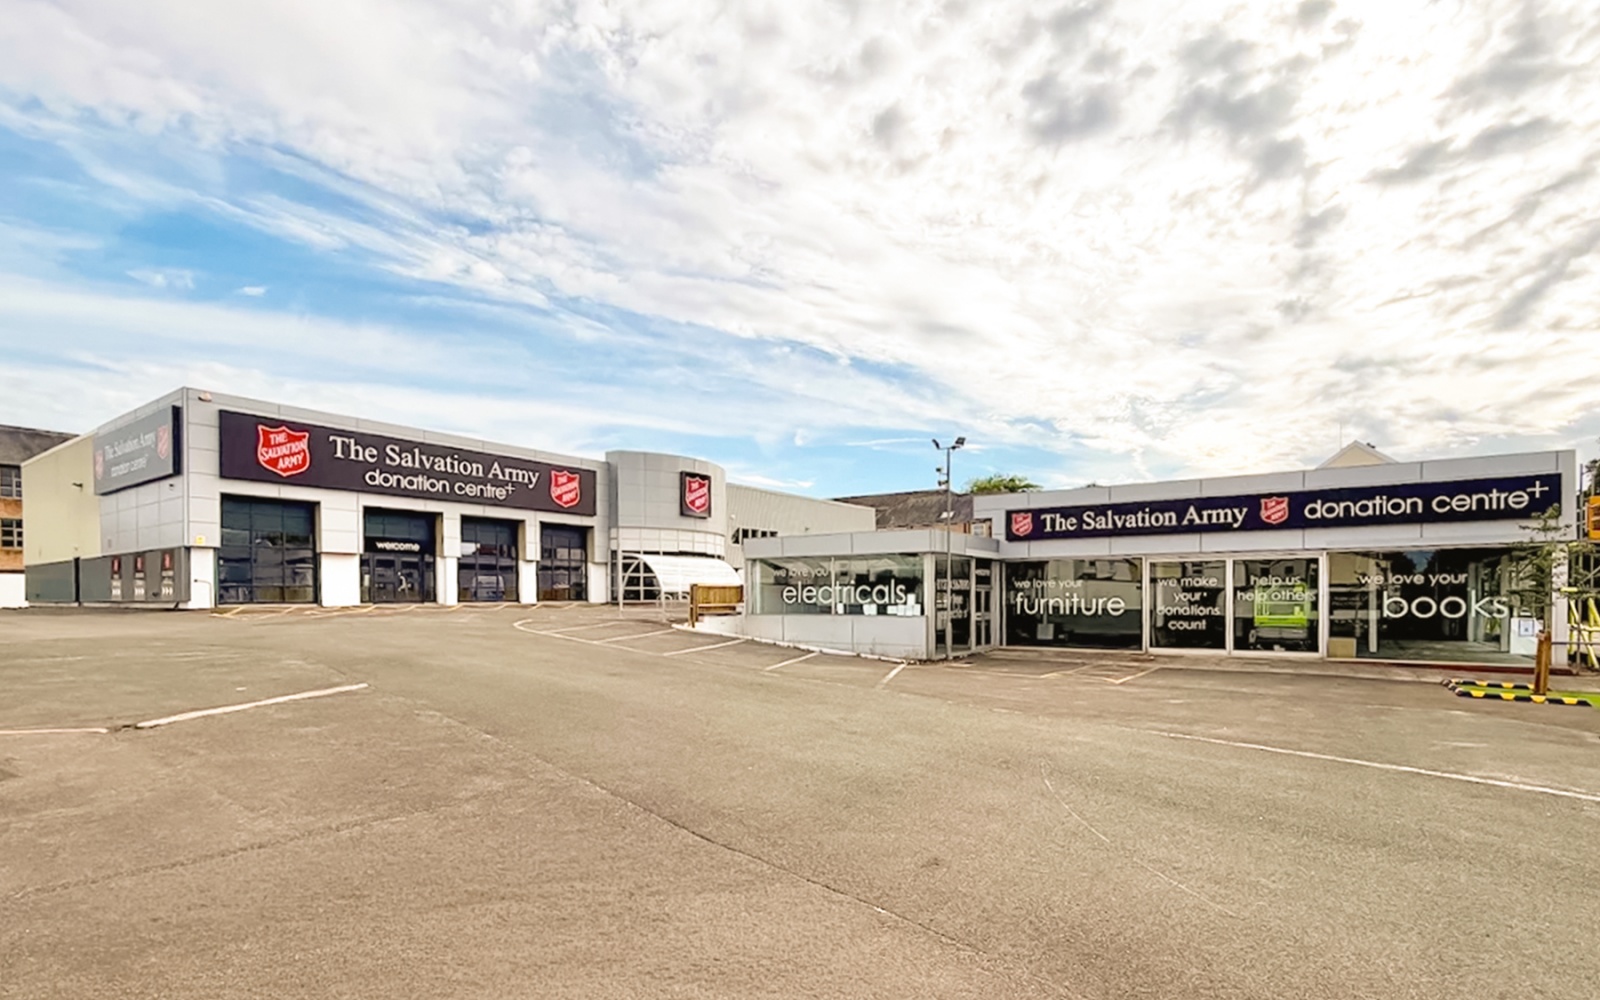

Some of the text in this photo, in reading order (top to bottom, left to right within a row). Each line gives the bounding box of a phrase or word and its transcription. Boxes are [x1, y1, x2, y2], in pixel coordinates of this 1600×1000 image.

[269, 432, 288, 445] THE
[277, 451, 304, 469] ARMY
[329, 435, 378, 463] The
[385, 443, 484, 477] Salvation
[488, 461, 540, 489] Army
[365, 468, 450, 494] donation
[375, 540, 420, 552] welcome
[1014, 578, 1084, 590] we love your
[1157, 575, 1218, 587] we make
[1250, 575, 1302, 588] help us
[1358, 572, 1468, 588] we love your
[782, 578, 907, 605] electricals
[1173, 591, 1202, 602] your
[1236, 589, 1317, 604] help others
[1015, 592, 1125, 616] furniture
[1156, 603, 1221, 616] donations
[1382, 590, 1510, 619] books
[1168, 619, 1206, 630] count
